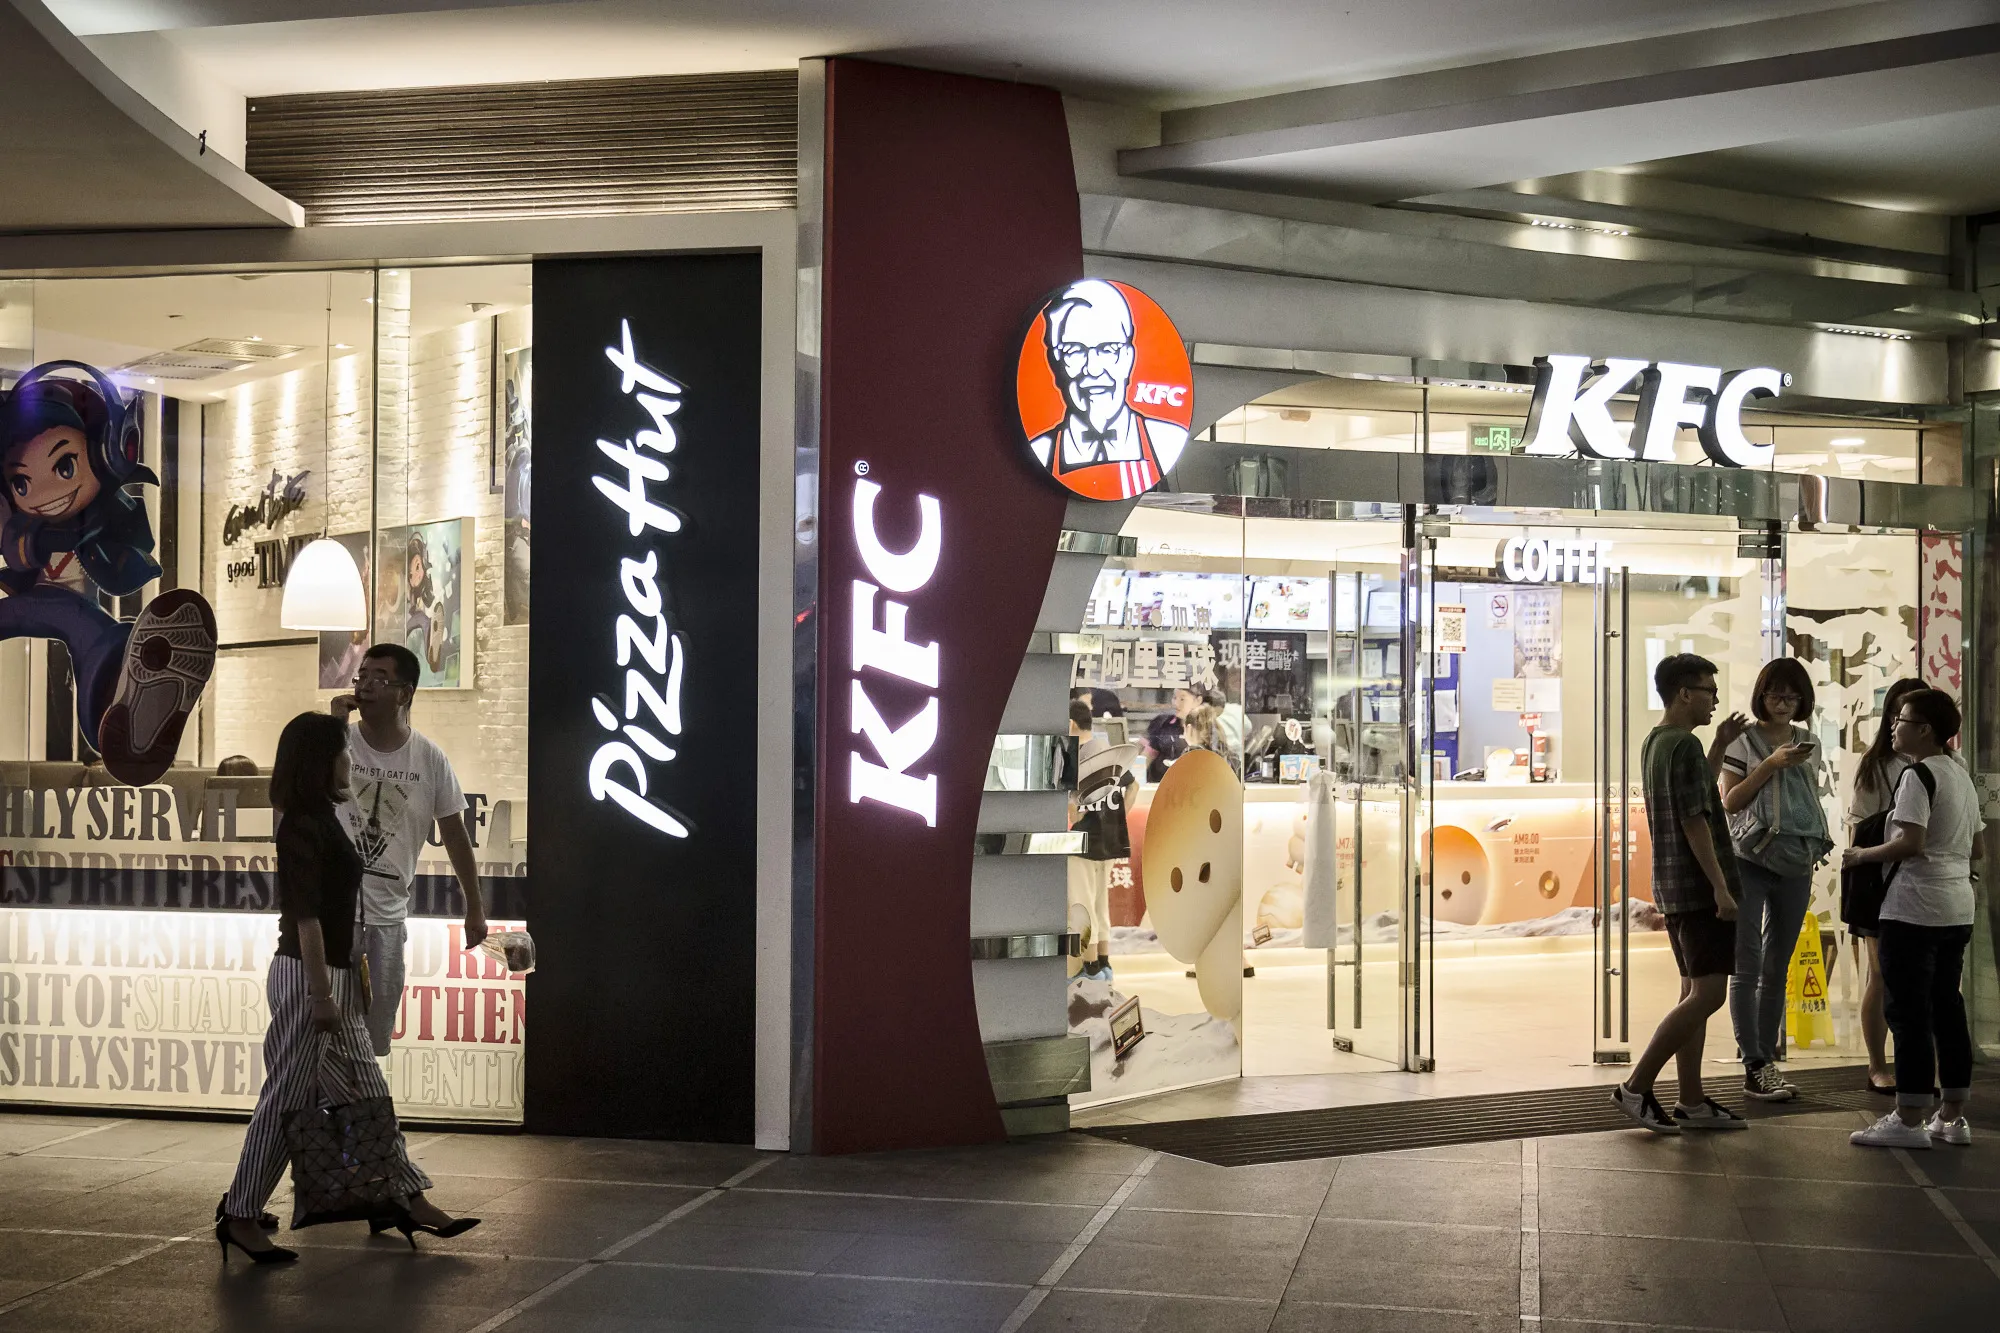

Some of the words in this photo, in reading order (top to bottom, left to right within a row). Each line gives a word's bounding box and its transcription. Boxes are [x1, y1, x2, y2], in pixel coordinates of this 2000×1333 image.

[591, 318, 682, 536] Hut
[1133, 382, 1187, 407] KFC
[1520, 354, 1782, 468] KFC
[589, 550, 689, 838] Pizza
[850, 478, 942, 828] KFC
